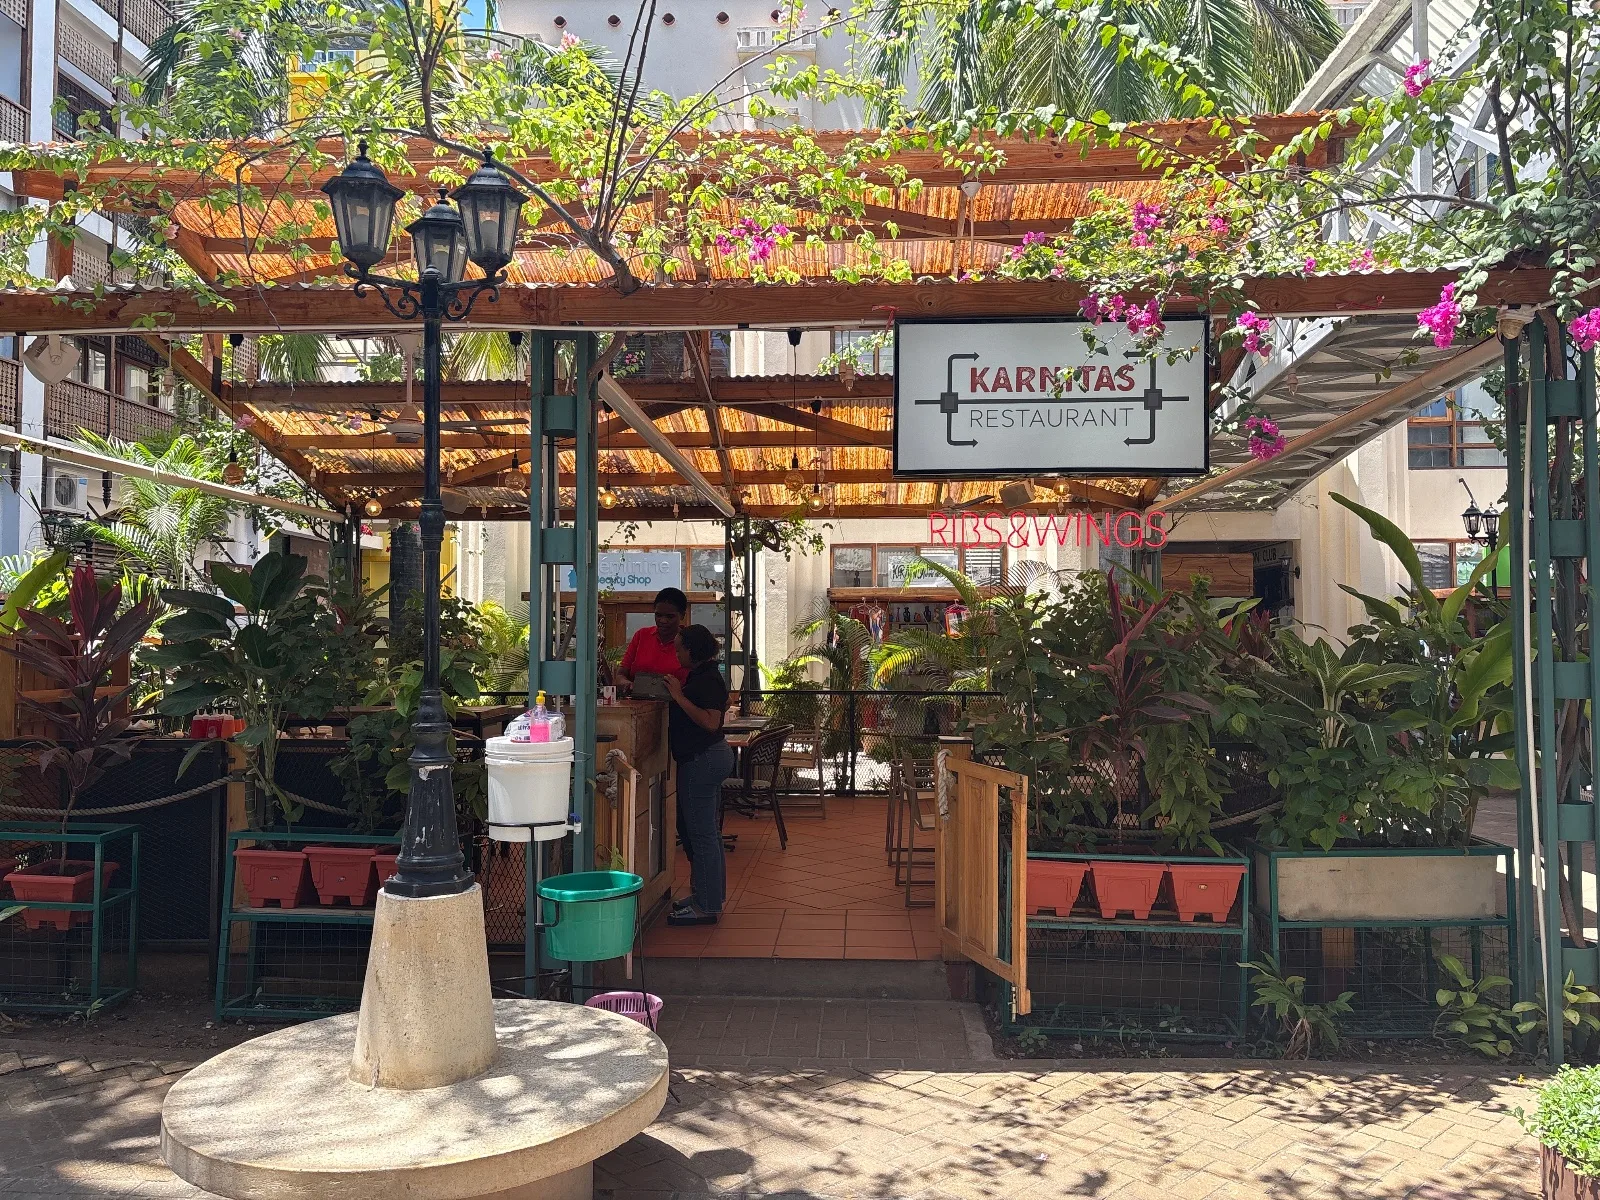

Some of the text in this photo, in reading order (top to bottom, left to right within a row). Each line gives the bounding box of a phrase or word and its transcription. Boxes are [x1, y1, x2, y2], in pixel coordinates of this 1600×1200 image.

[970, 364, 1136, 393] KARNITAS
[970, 407, 1134, 428] RESTAURANT
[929, 511, 1168, 548] RIBS&WINGS
[1262, 547, 1277, 562] CLUB
[598, 558, 670, 574] eminine
[627, 574, 651, 586] Shop
